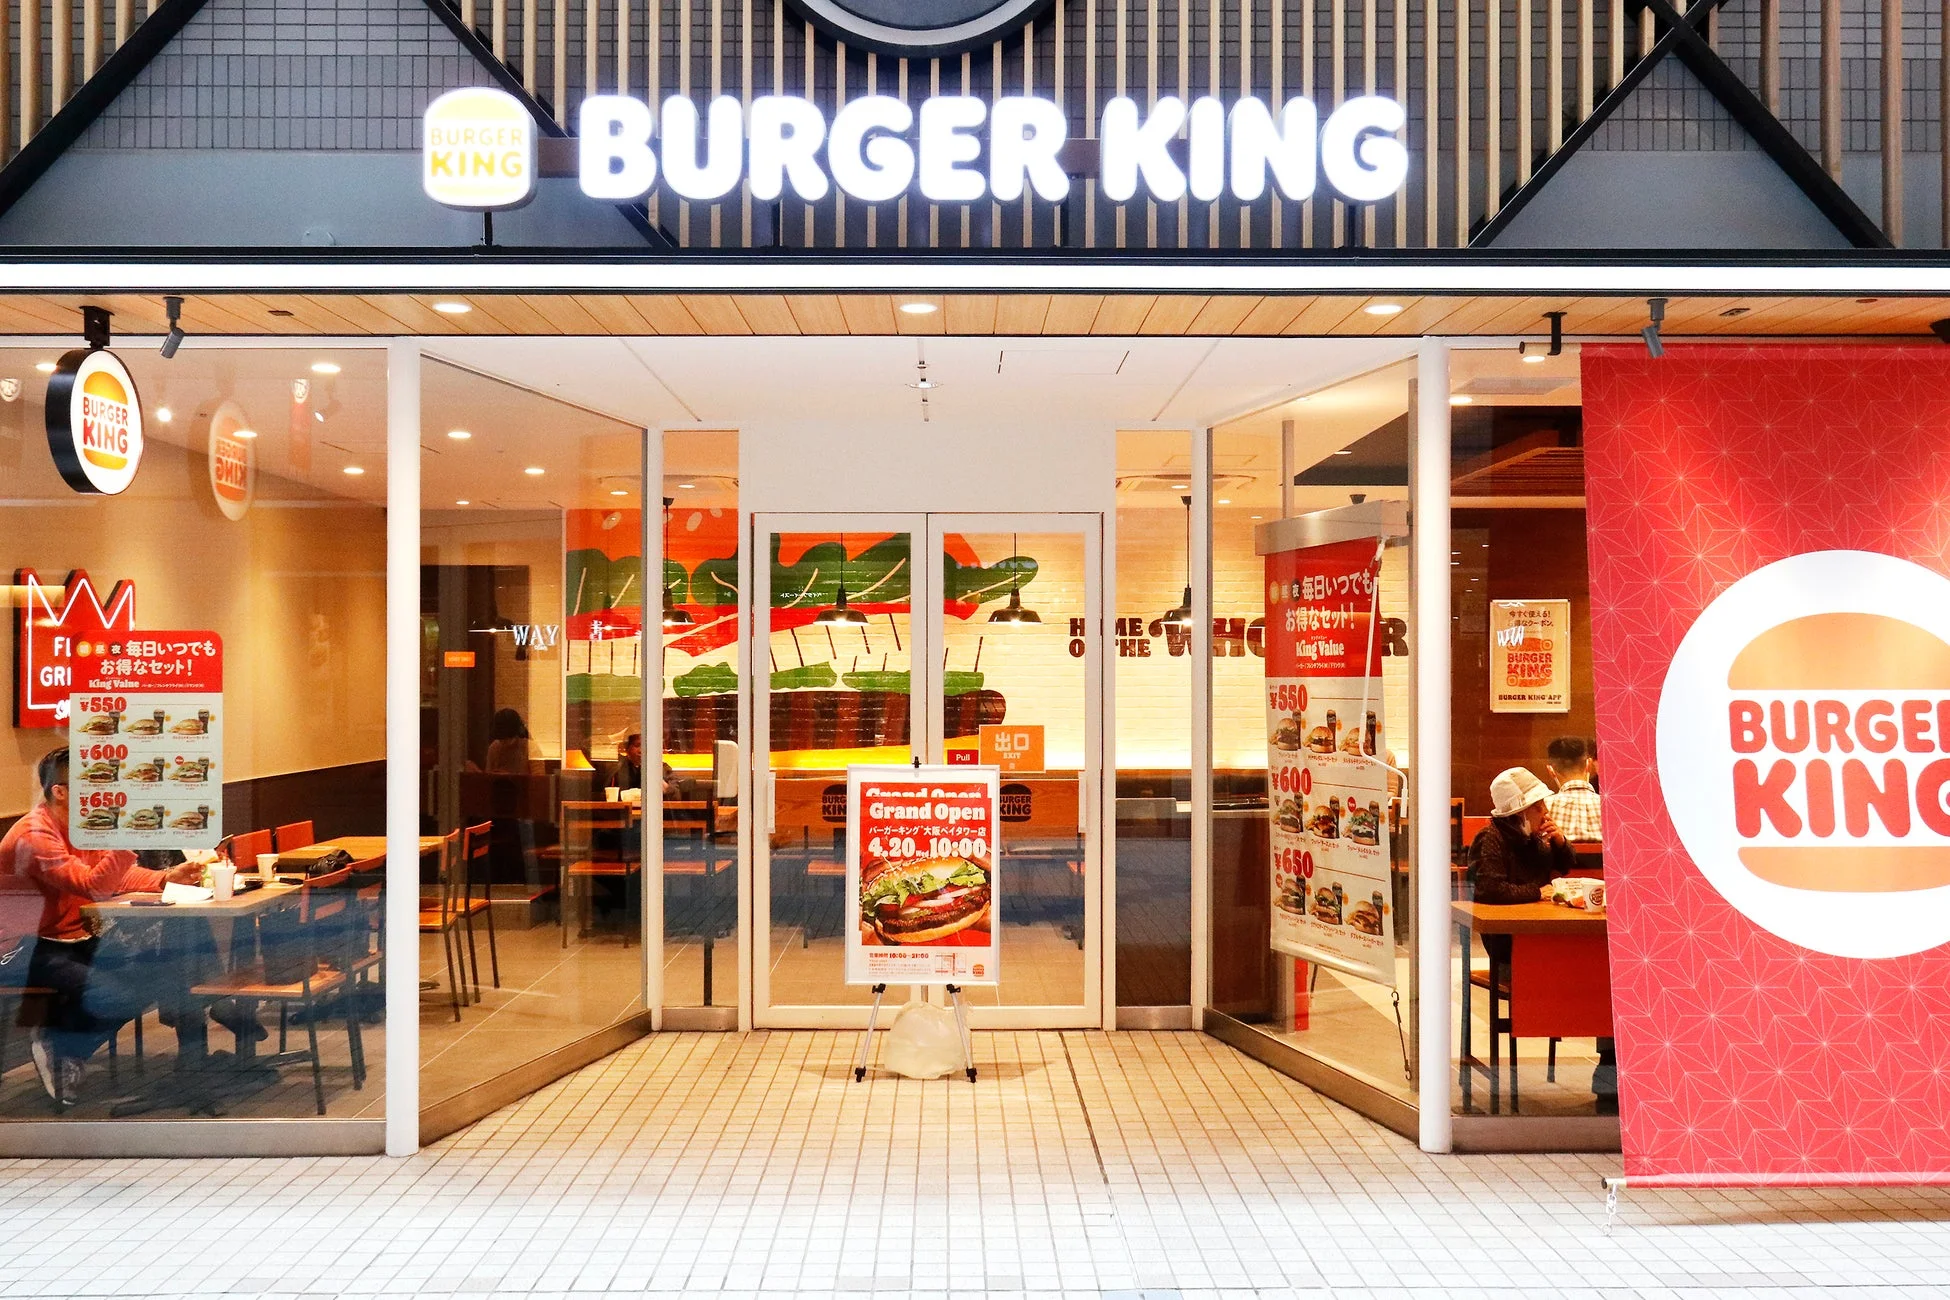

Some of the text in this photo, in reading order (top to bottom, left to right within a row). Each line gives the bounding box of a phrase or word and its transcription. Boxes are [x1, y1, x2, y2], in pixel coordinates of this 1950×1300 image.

[431, 128, 522, 145] BURGER
[579, 95, 1409, 201] BURGER KING
[431, 151, 522, 177] KING
[83, 396, 128, 426] BURGER
[83, 418, 128, 454] KING
[1302, 568, 1373, 601] 毎日いつでも
[1285, 602, 1355, 632] お得なセット!
[1069, 618, 1143, 636] HME
[54, 637, 72, 657] FL
[126, 640, 216, 657] 毎日いつでも
[1115, 639, 1150, 657] HE
[1296, 639, 1345, 660] King Value
[1507, 653, 1552, 663] BURGER
[40, 666, 72, 687] GRI
[100, 659, 192, 676] お得なセット!
[1507, 664, 1552, 678] KING
[89, 678, 112, 690] King
[113, 679, 140, 689] Value
[80, 697, 127, 713] ¥550
[1269, 684, 1308, 712] ¥550
[1729, 700, 1950, 754] BURGE
[995, 732, 1029, 752] 出口
[80, 744, 129, 761] ¥600
[956, 753, 971, 761] Pull
[1003, 751, 1021, 759] EXIT
[1271, 766, 1312, 796] ¥600
[80, 792, 128, 808] ¥650
[822, 795, 847, 804] BURG
[1000, 795, 1032, 804] URGER
[822, 804, 847, 816] KIN
[869, 802, 986, 824] Grand Open
[1000, 803, 1032, 816] KING
[868, 836, 916, 858] 4.20
[929, 837, 987, 859] 10:00
[1273, 847, 1314, 879] ¥650
